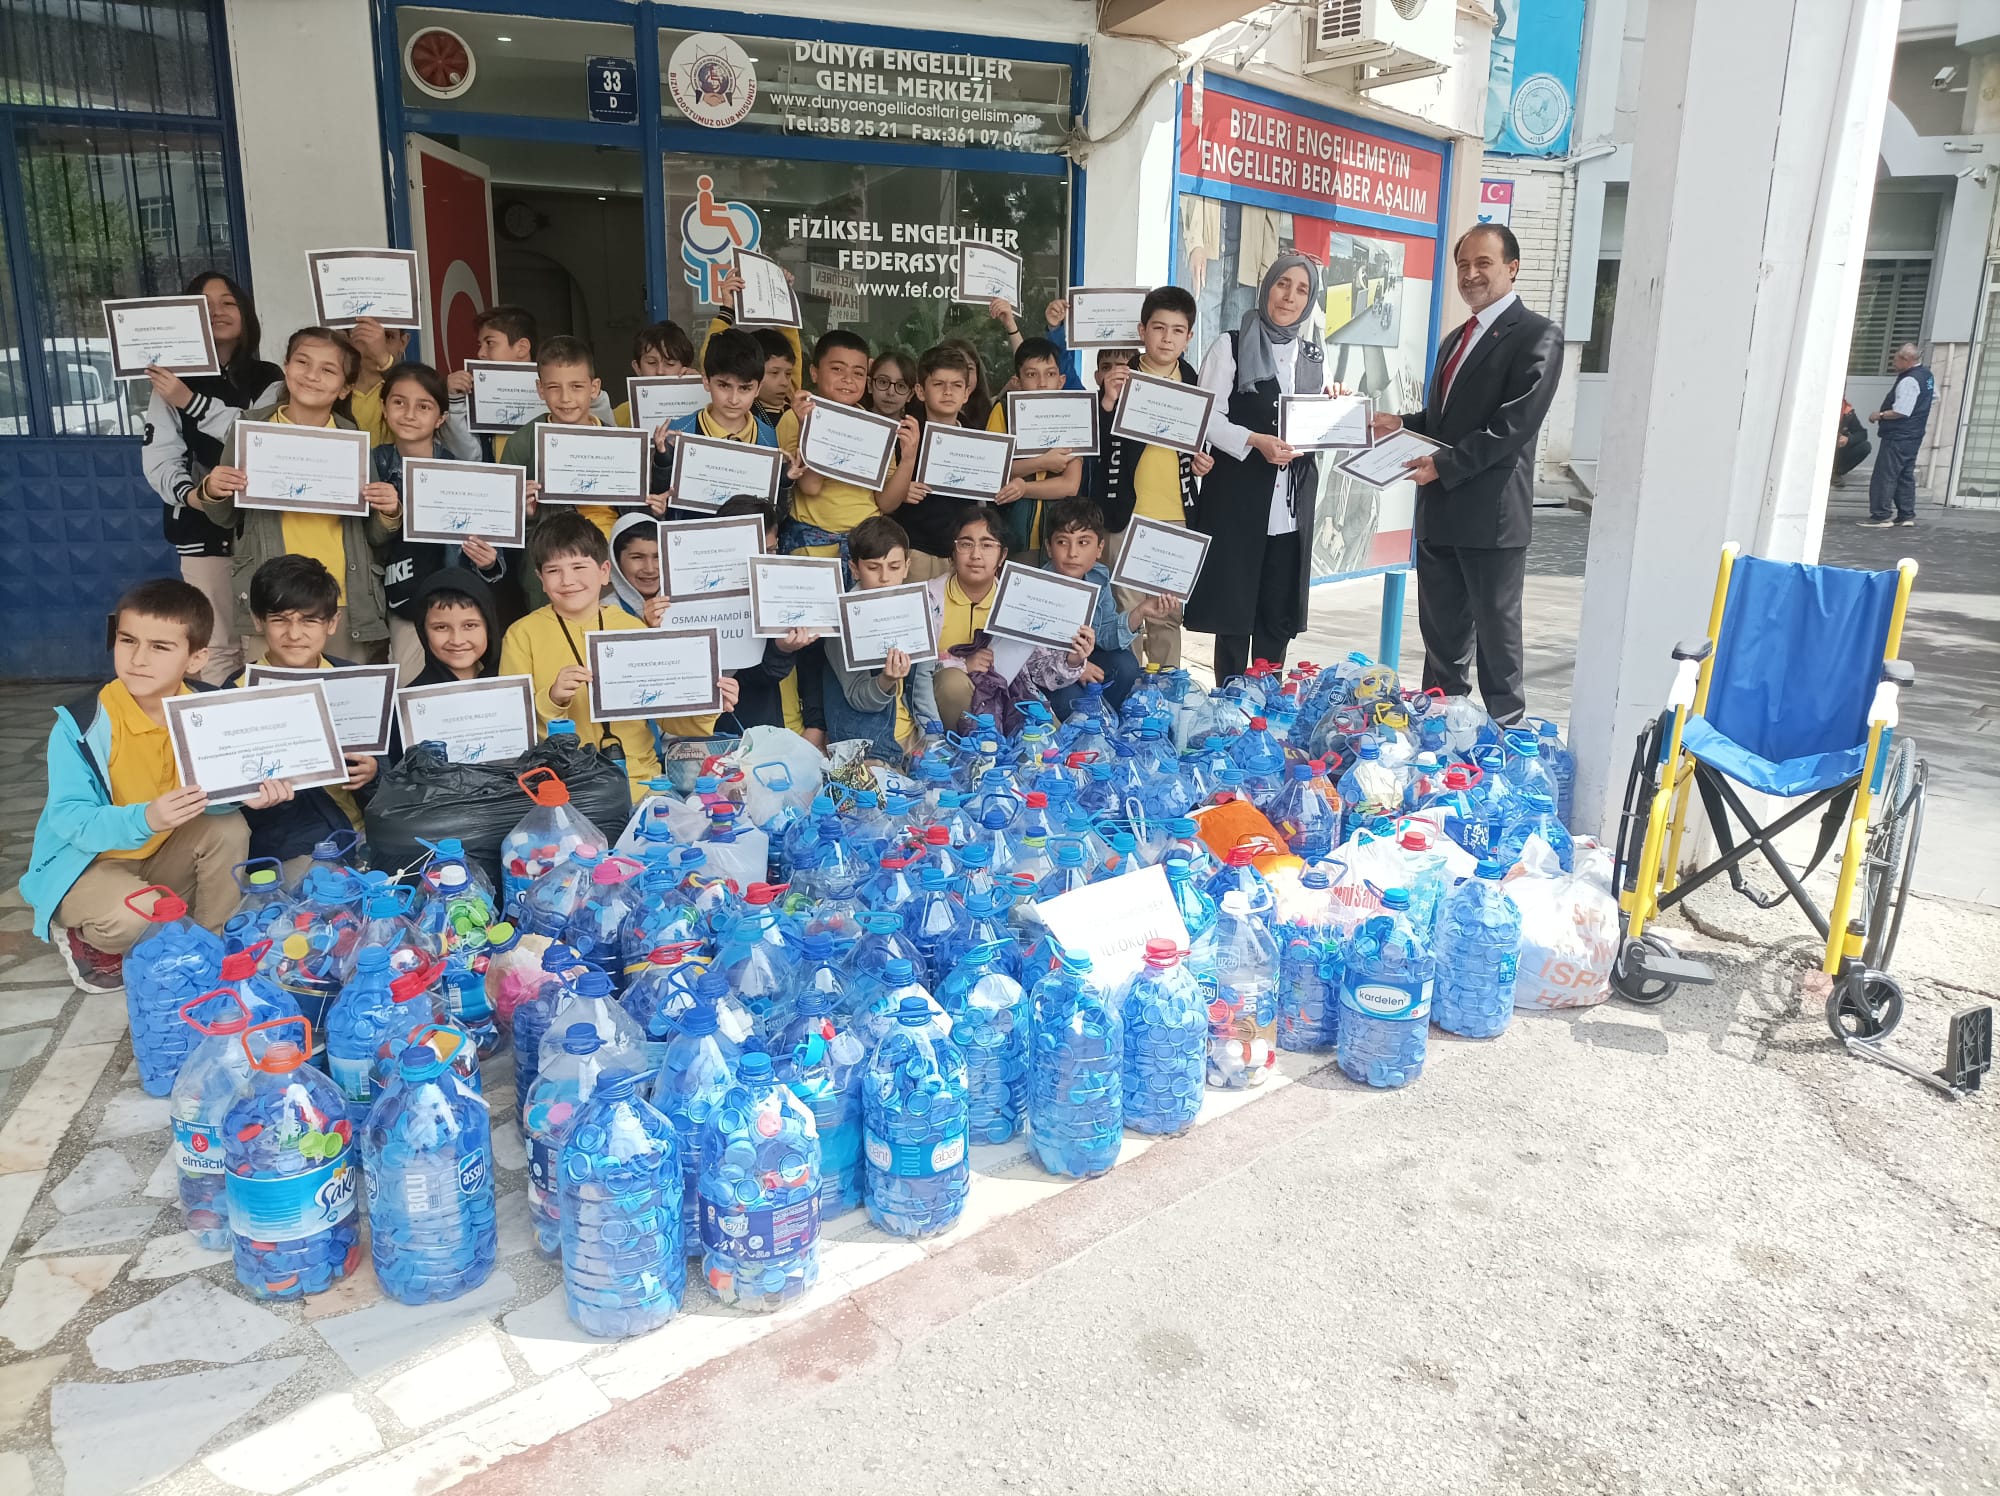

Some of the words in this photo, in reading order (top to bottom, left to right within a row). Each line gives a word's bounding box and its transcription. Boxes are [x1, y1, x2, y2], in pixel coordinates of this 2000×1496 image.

[795, 39, 875, 70] DÜNYA
[883, 47, 1012, 82] ENGELLİLER
[603, 70, 621, 92] 33
[816, 70, 888, 96] GENEL
[897, 78, 992, 104] MERKEZİ
[610, 96, 617, 108] D
[716, 116, 736, 127] OLUR
[786, 114, 849, 134] Tel:358
[854, 121, 874, 136] 25
[879, 122, 897, 138] 21
[911, 124, 974, 144] Fax:361
[980, 130, 999, 145] 07
[1003, 131, 1021, 147] 06
[1302, 163, 1370, 204] BERABER
[1374, 181, 1427, 216] AŞALIM
[788, 214, 884, 242] FİZİKSEL
[891, 222, 1019, 250] ENGELLİLER
[838, 249, 960, 275] FEDERASYO
[671, 614, 708, 625] OSMAN
[710, 610, 742, 622] HAMDİ
[1359, 990, 1404, 1007] kardelen
[462, 1160, 484, 1185] assu
[901, 1146, 920, 1176] BOLU
[406, 1174, 429, 1213] BOLU
